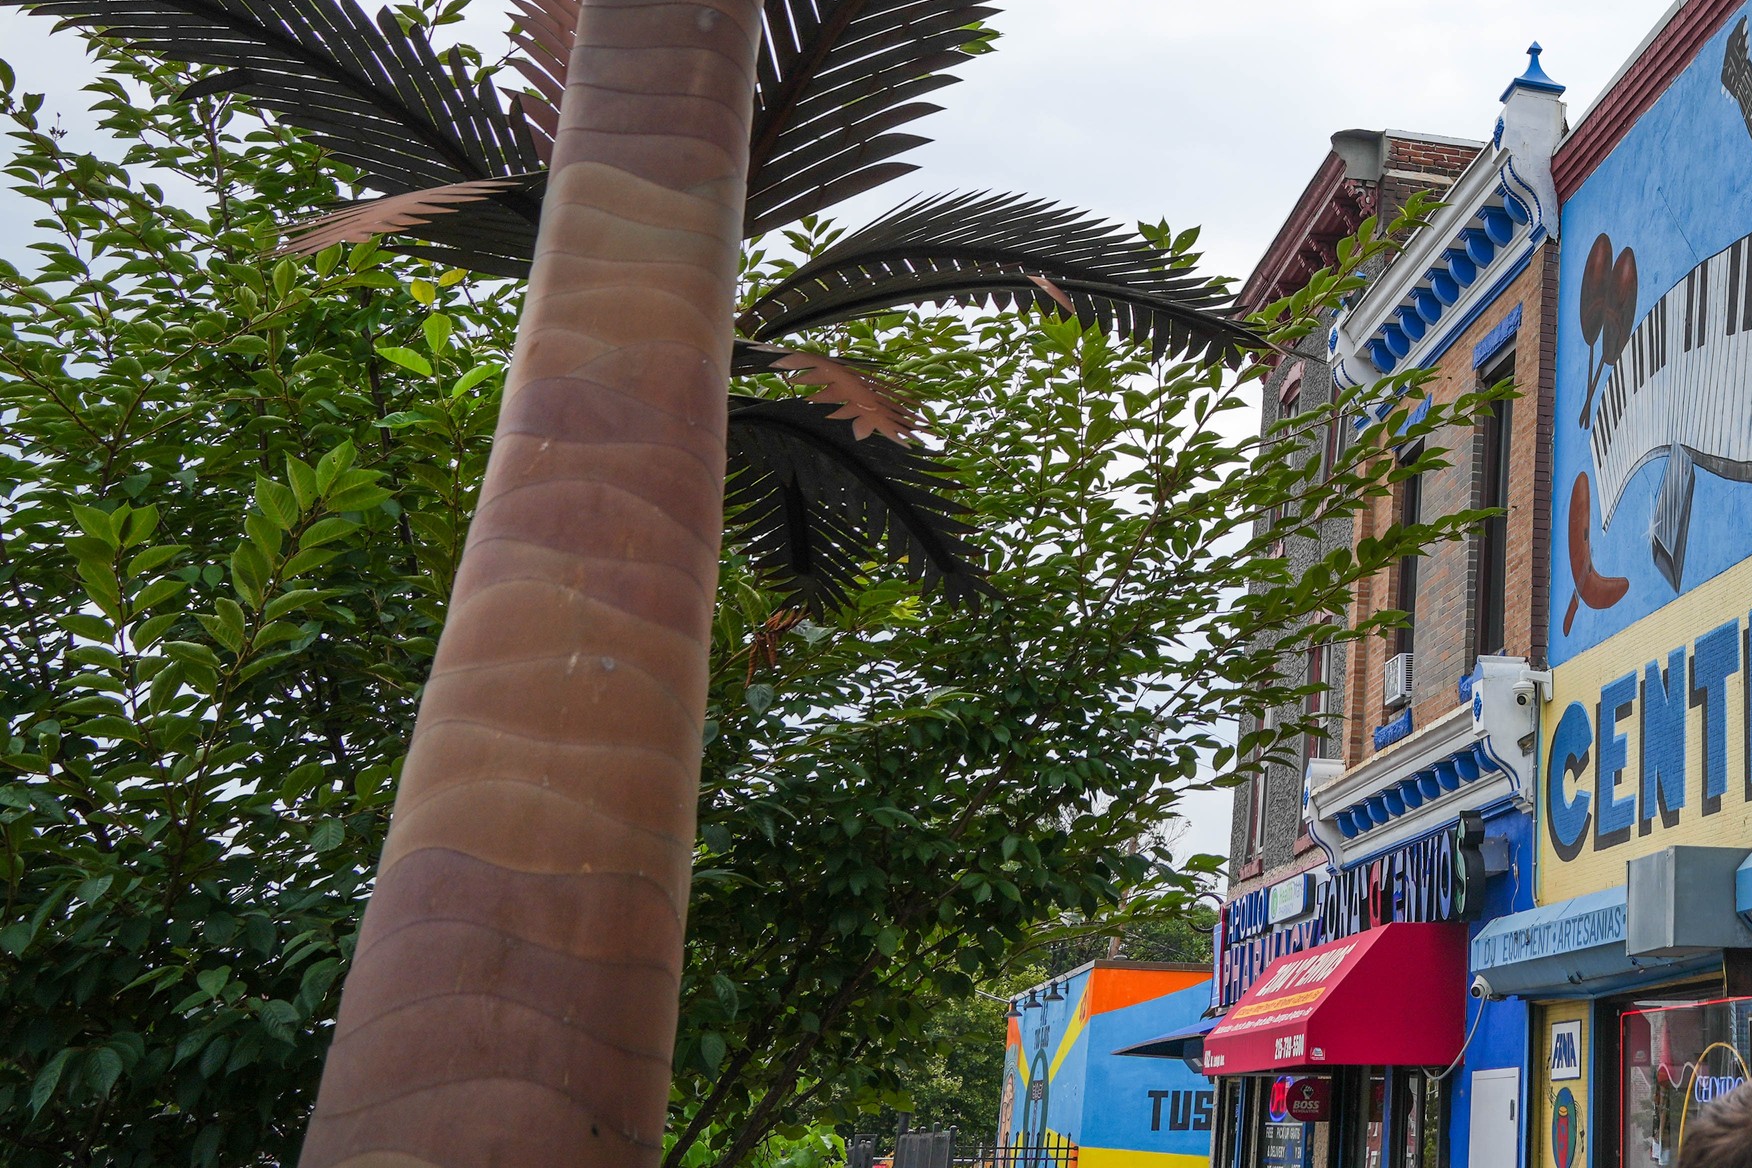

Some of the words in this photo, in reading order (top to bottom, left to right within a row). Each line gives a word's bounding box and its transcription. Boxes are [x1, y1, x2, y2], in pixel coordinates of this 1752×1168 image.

[1227, 886, 1266, 945] APOLLO
[1484, 938, 1496, 967] DJ
[1556, 906, 1621, 951] ARTESANIAS
[1293, 1100, 1320, 1109] BOSS
